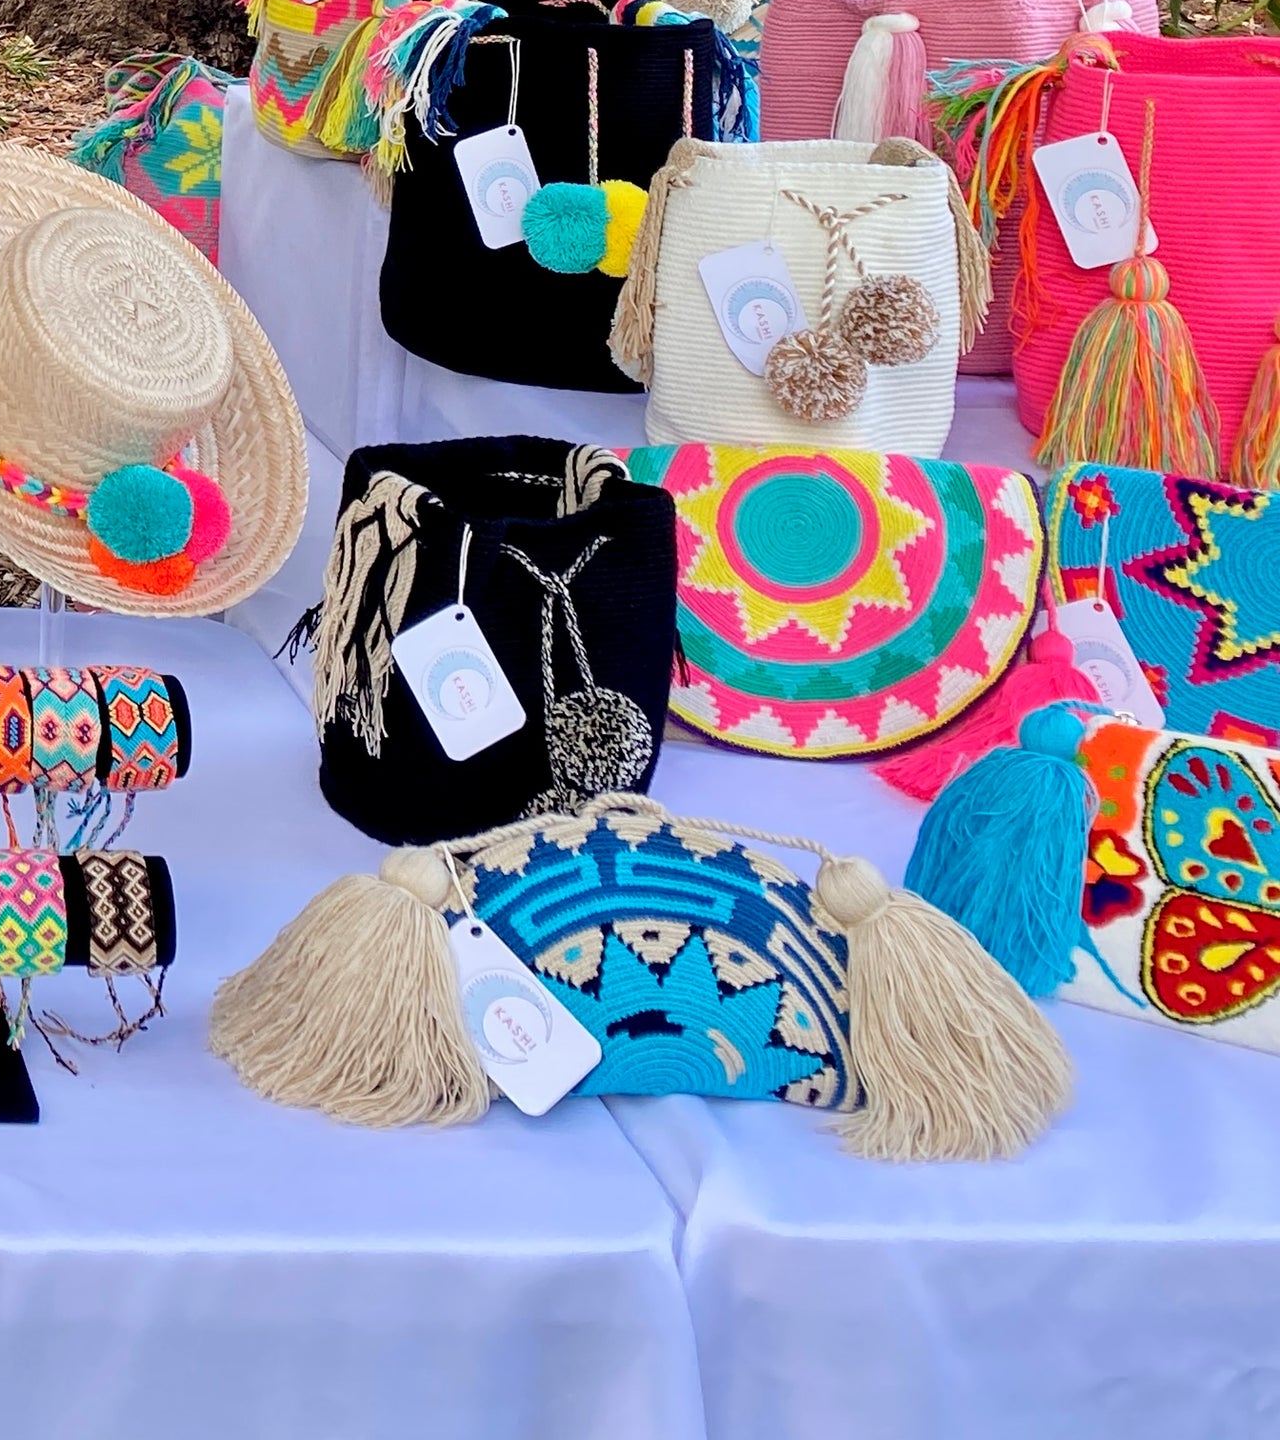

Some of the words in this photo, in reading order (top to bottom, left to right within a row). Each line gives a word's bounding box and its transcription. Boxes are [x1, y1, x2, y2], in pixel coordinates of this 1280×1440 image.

[1090, 195, 1111, 229] KASHI
[752, 304, 773, 339] KASHI
[452, 676, 477, 712] KASHI
[1089, 664, 1113, 703] KASHI
[494, 1006, 537, 1051] KASHI
